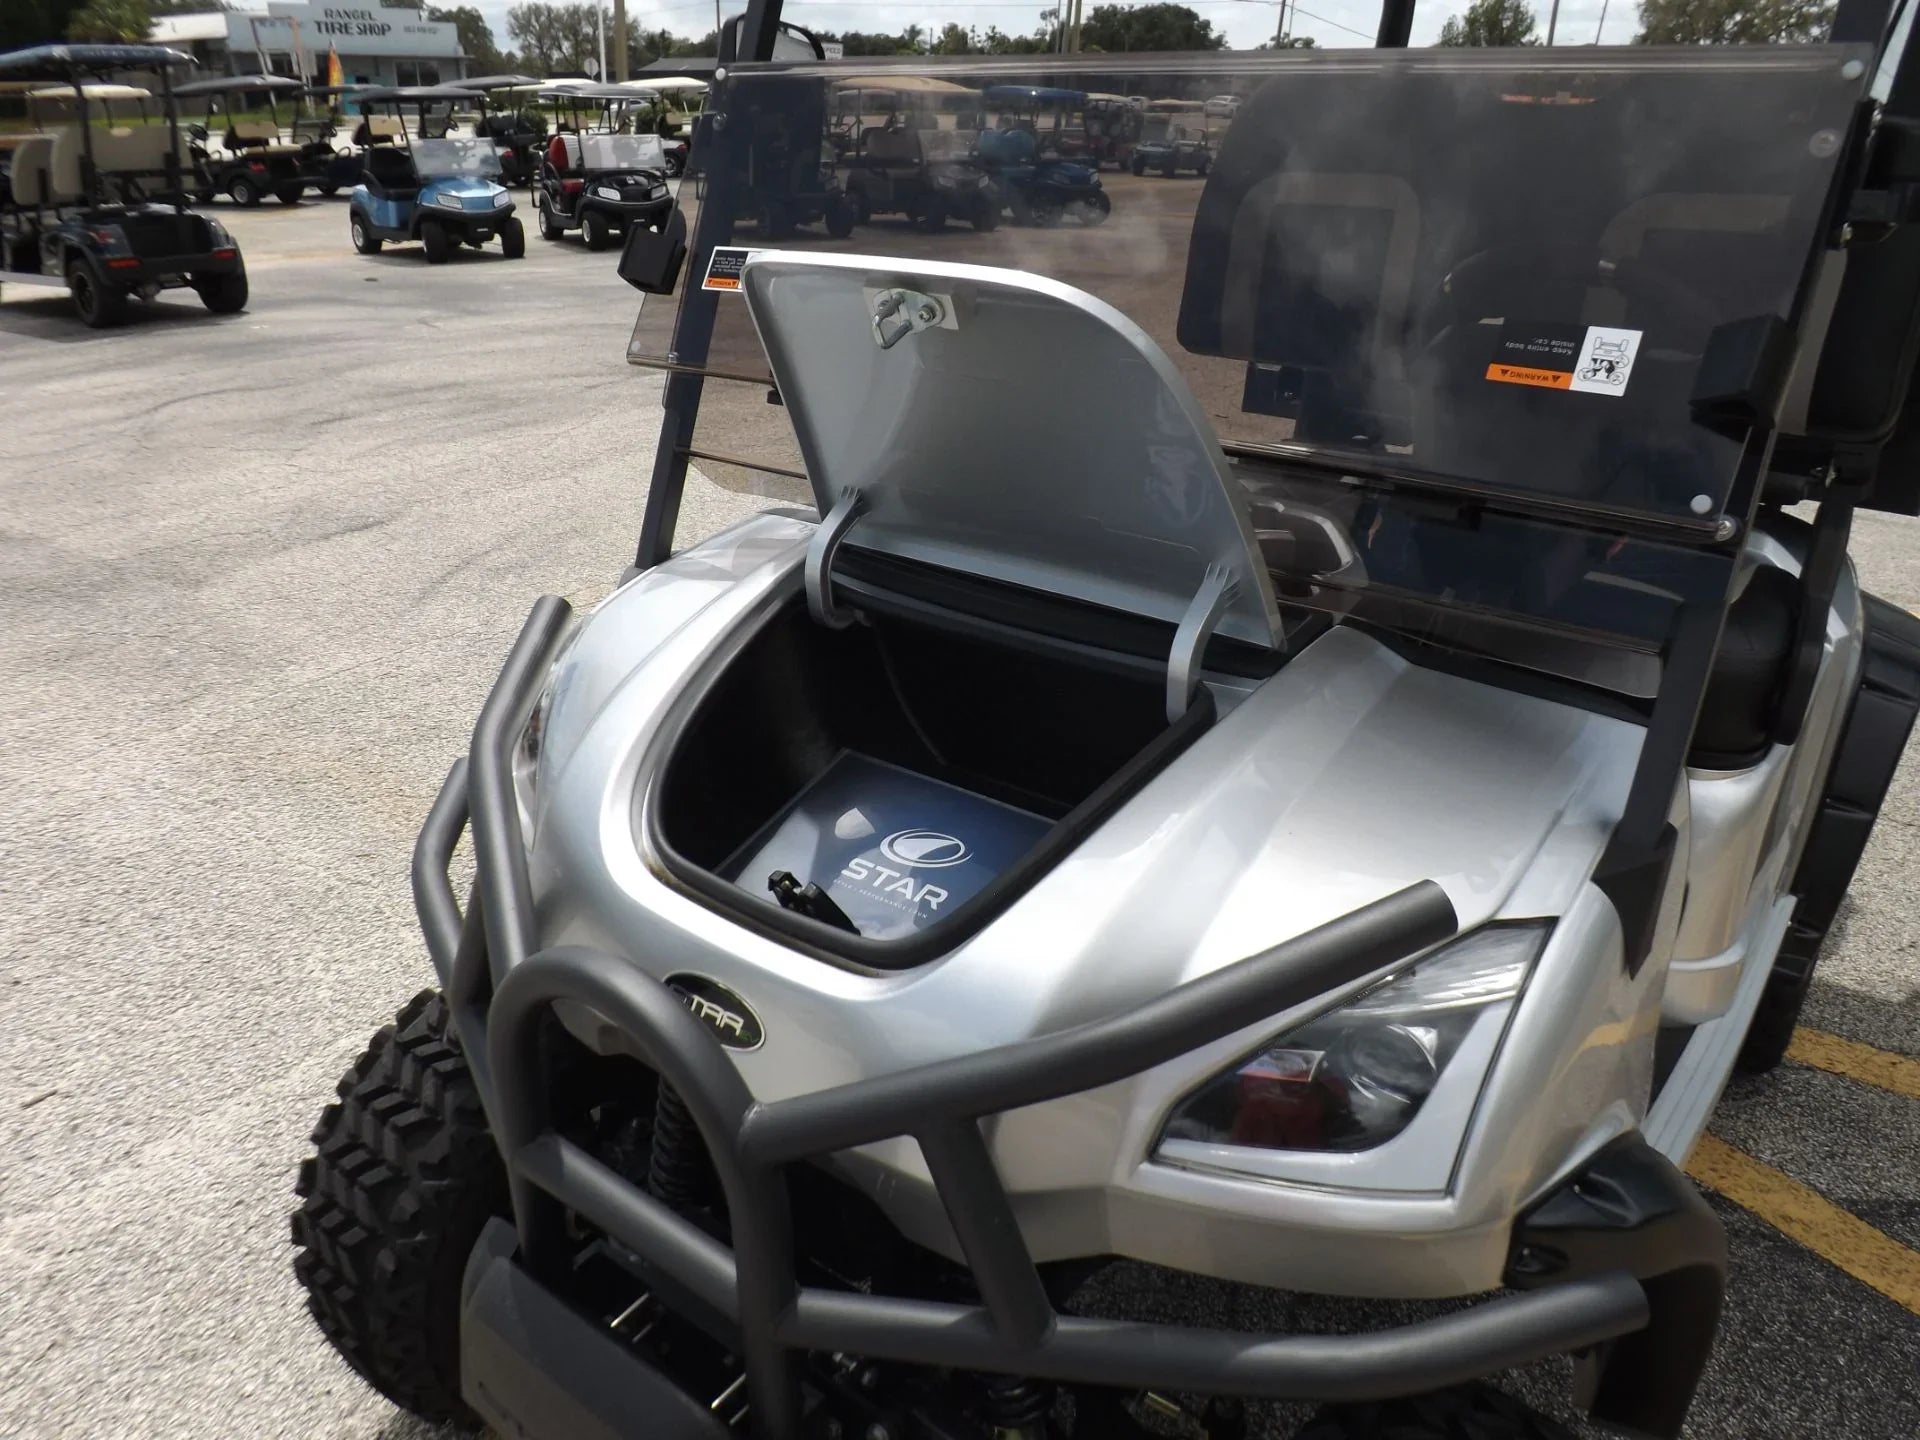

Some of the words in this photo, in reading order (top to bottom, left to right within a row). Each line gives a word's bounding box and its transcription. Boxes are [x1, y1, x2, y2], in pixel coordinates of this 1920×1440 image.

[324, 8, 377, 21] RANGEL
[314, 21, 353, 35] TIRE
[356, 22, 392, 37] SHOP
[1505, 341, 1525, 350] body
[1526, 344, 1549, 352] entire
[1550, 339, 1575, 347] inside
[1552, 347, 1573, 356] Keep
[1509, 371, 1549, 382] WARNING
[841, 857, 949, 911] STAR
